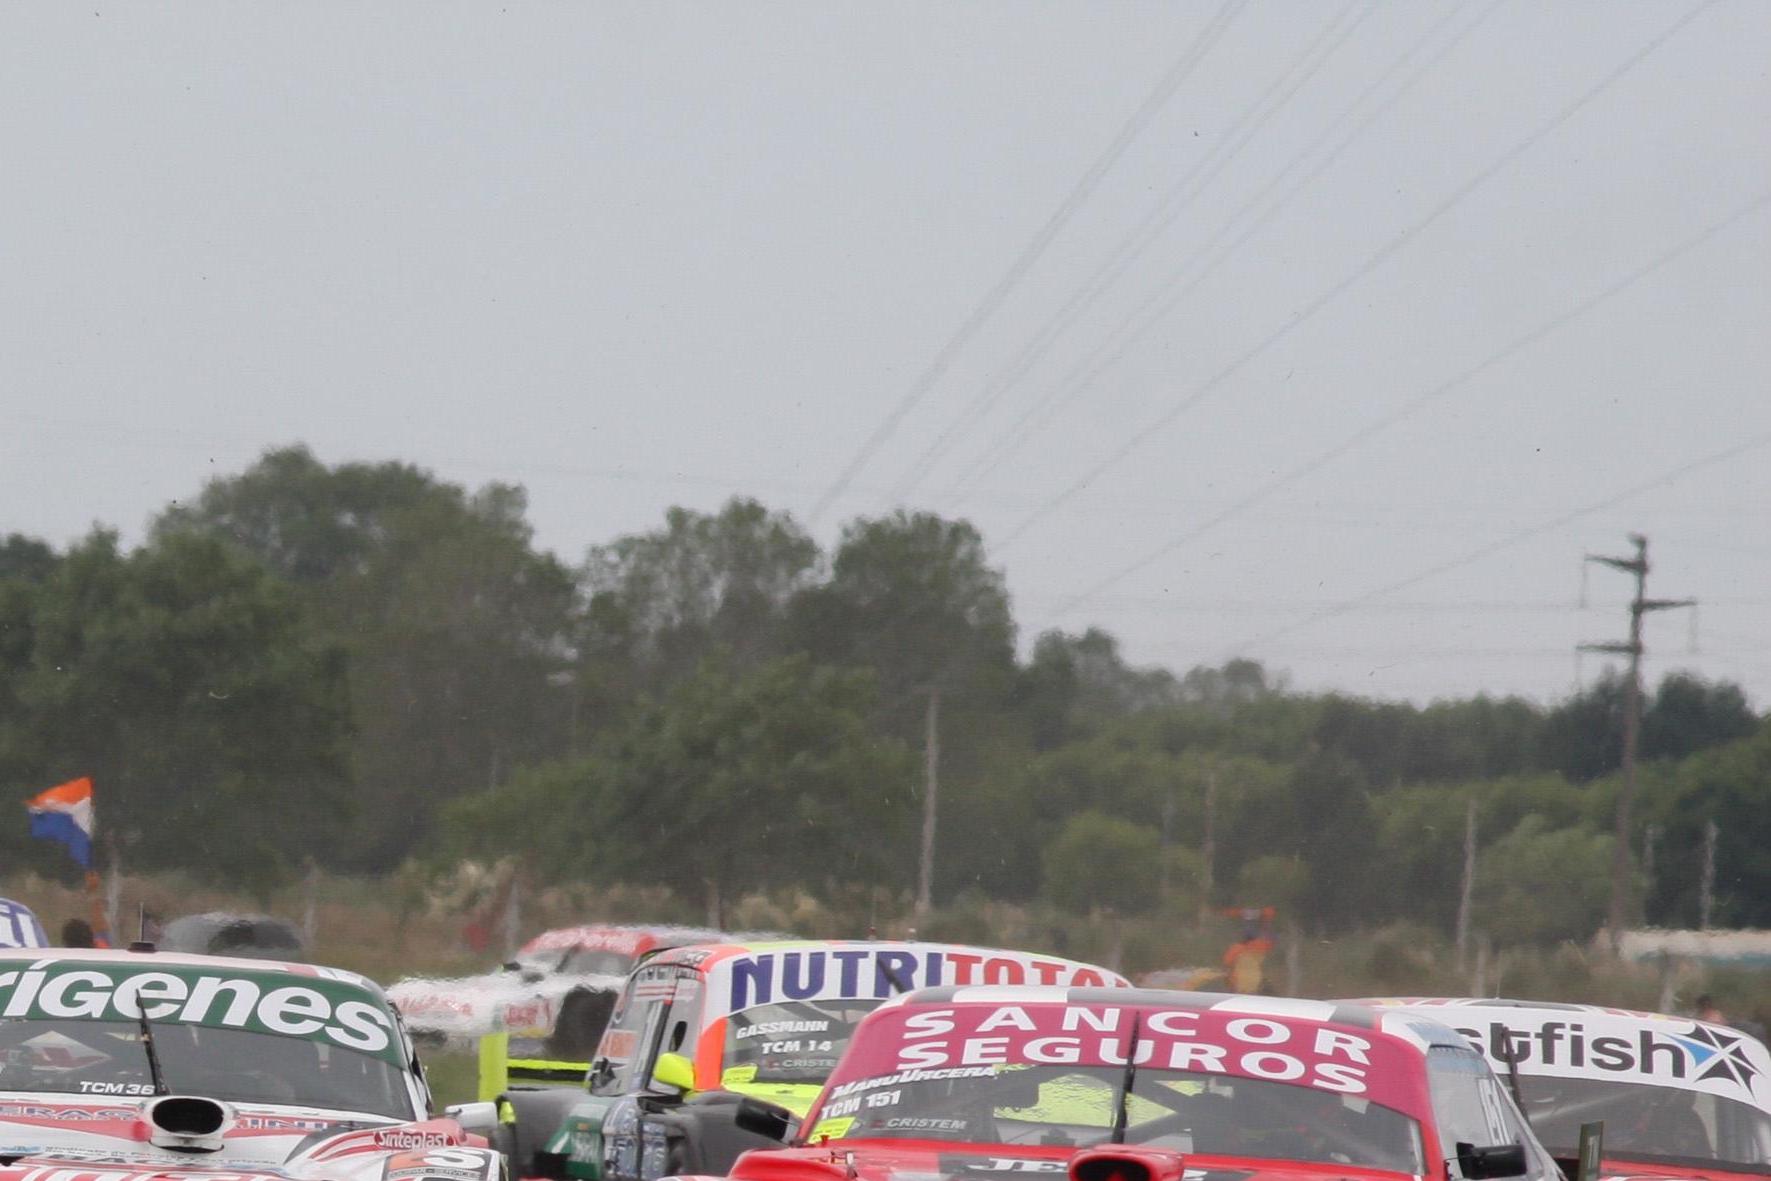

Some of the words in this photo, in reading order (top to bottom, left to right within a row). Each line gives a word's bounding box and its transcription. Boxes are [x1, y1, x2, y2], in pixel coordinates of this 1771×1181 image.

[736, 1020, 829, 1040] GASSMANN
[903, 1006, 1372, 1068] SANCOR
[761, 1040, 800, 1055] TCM
[807, 1039, 833, 1052] 14
[896, 1034, 1368, 1093] SEGUROS
[80, 1081, 123, 1095] TCM
[126, 1083, 156, 1096] 36
[820, 1096, 860, 1120] TCM
[865, 1090, 902, 1109] 151
[886, 1117, 968, 1131] CRISTEM
[376, 1131, 449, 1151] Sinteplast
